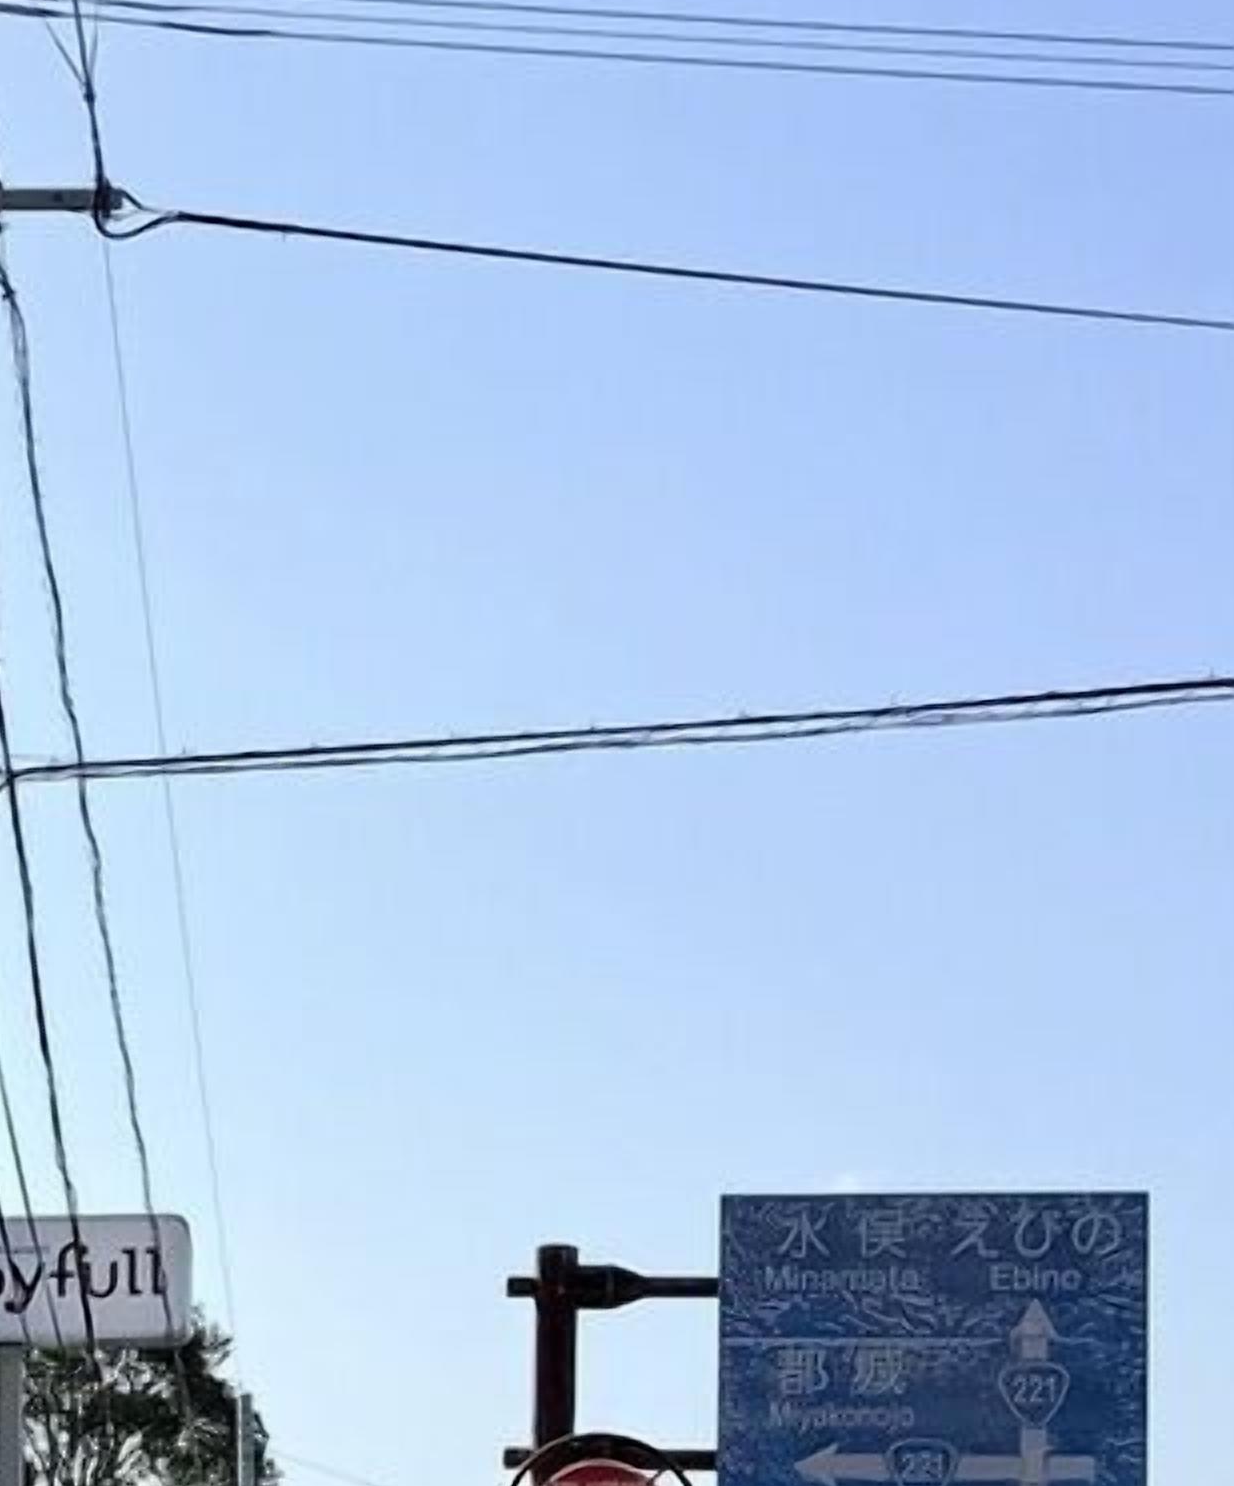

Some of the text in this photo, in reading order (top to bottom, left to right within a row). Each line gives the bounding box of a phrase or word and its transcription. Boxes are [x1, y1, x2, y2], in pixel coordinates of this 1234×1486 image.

[950, 1206, 1122, 1260] えびの
[989, 1264, 1082, 1292] Ebino
[1011, 1374, 1057, 1404] 221
